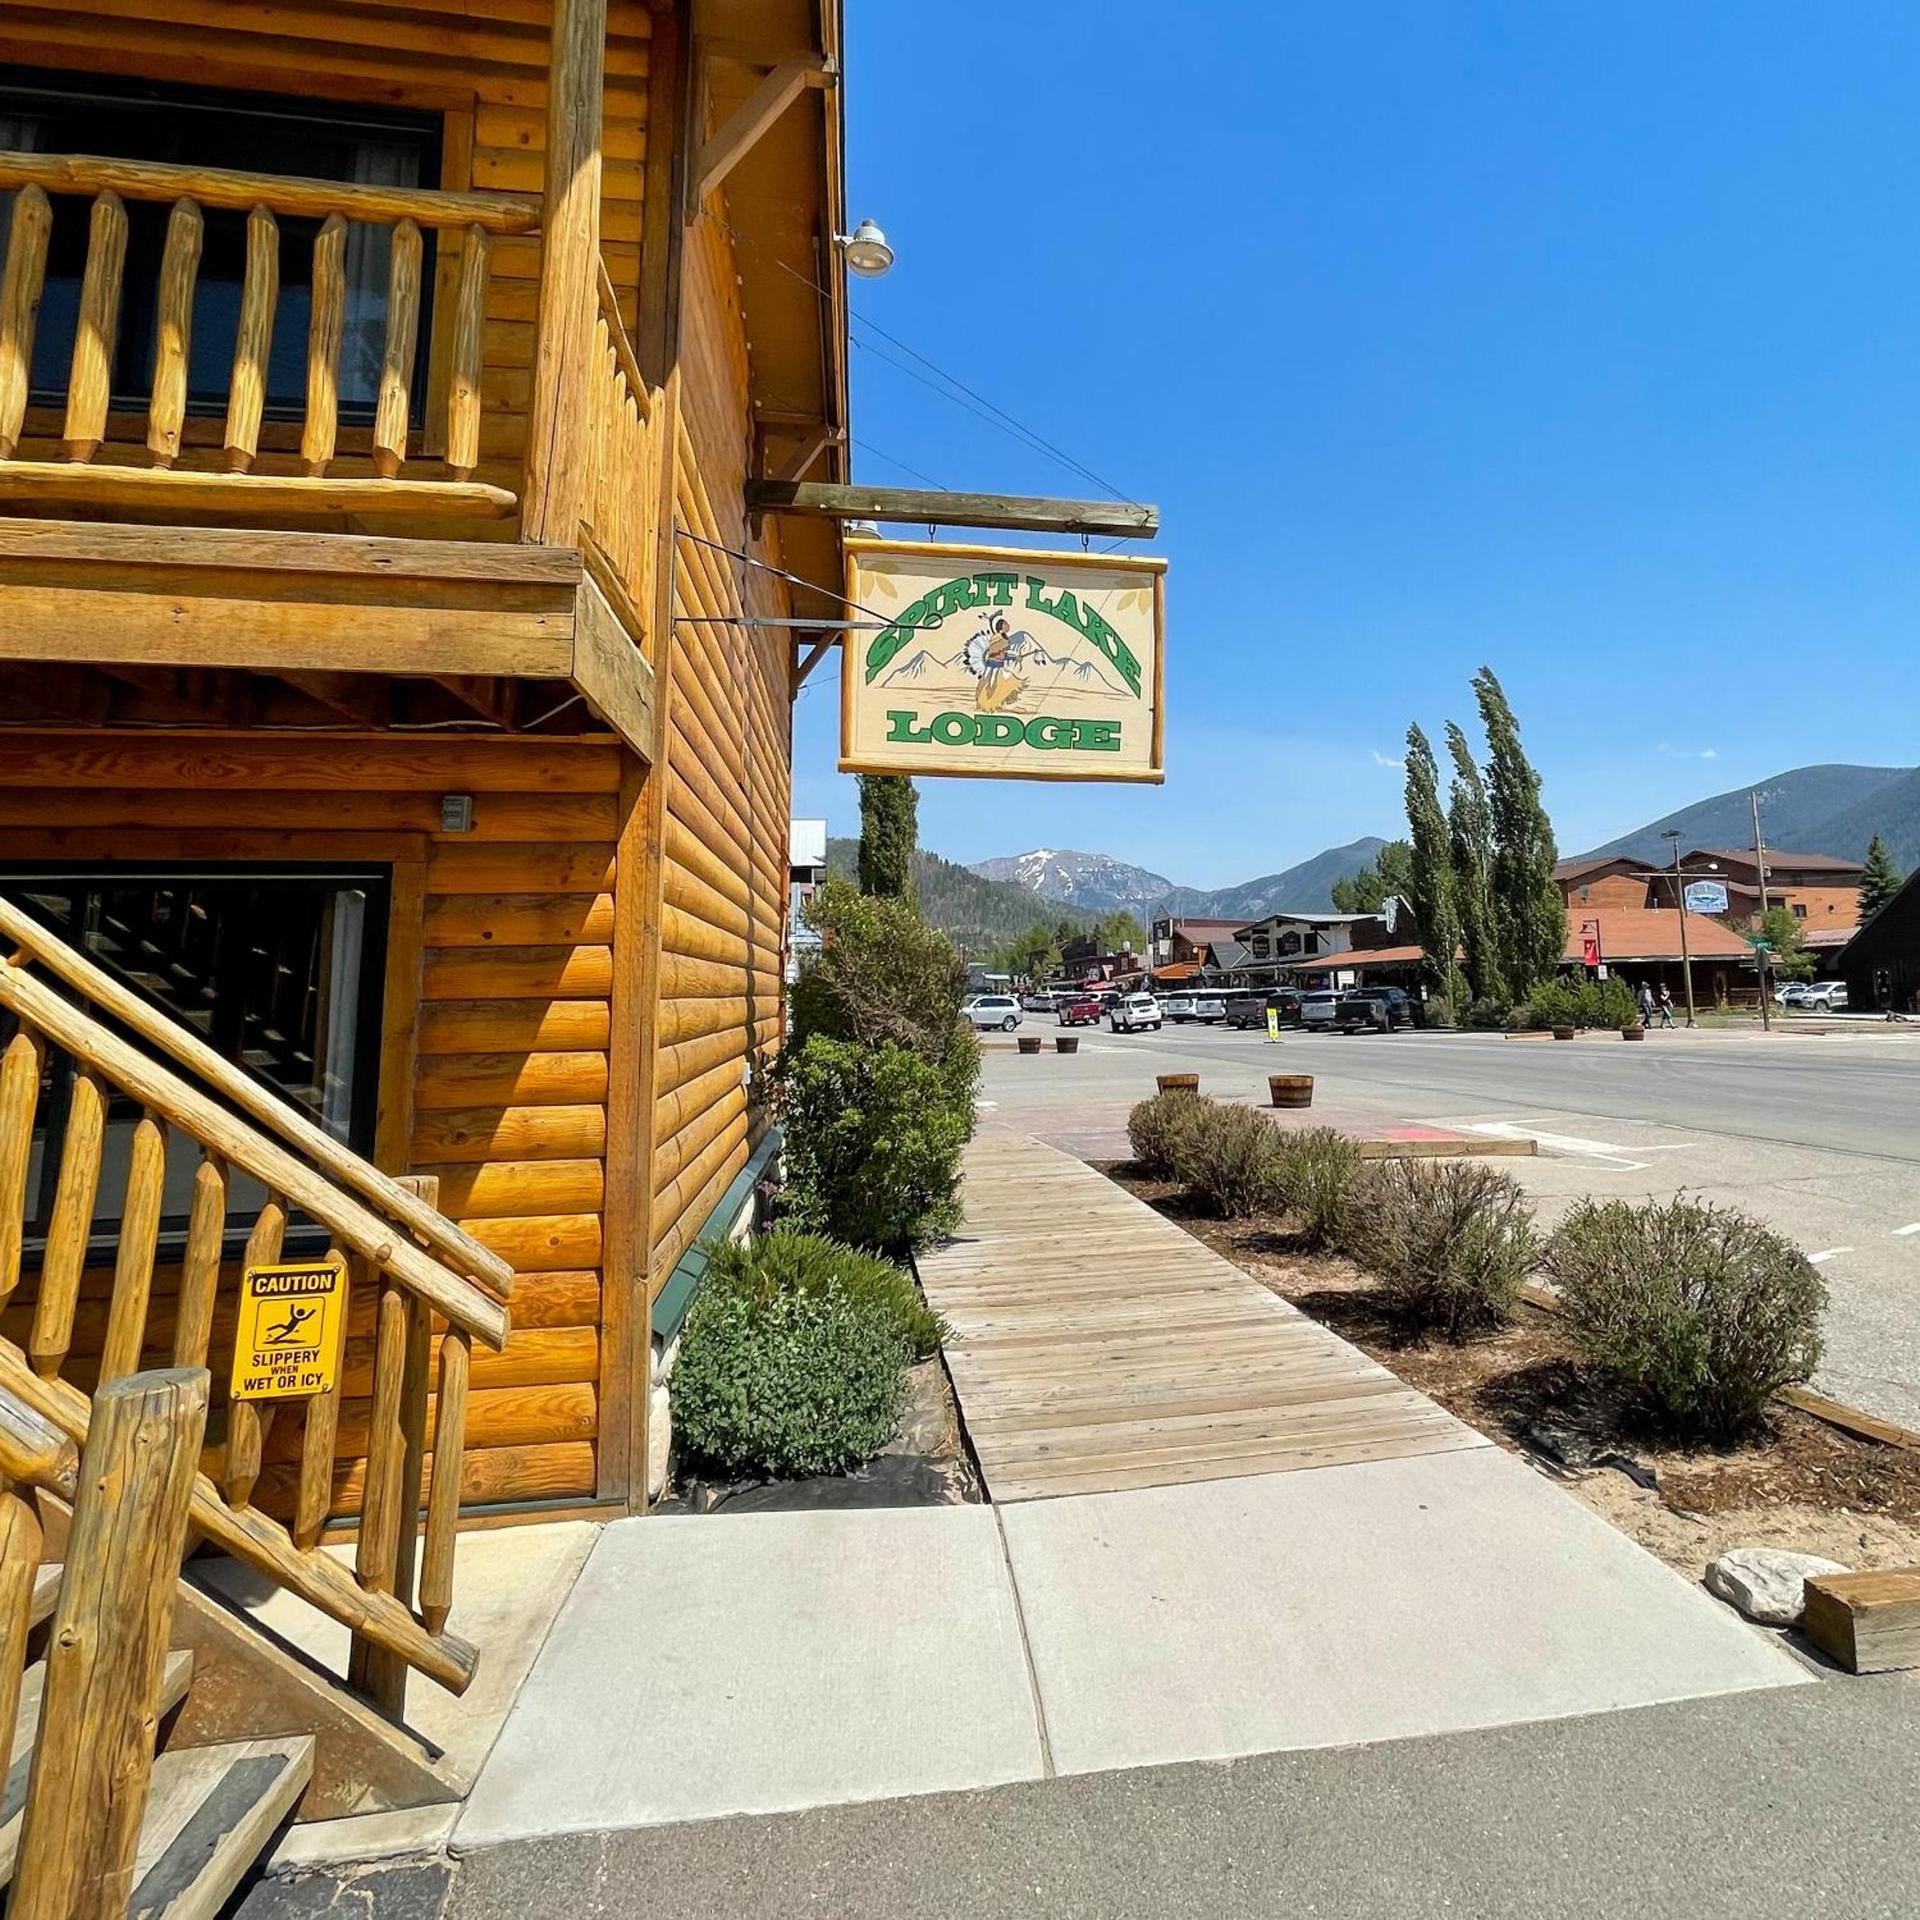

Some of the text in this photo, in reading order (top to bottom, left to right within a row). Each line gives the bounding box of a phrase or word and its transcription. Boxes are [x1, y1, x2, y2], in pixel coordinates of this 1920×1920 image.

[866, 572, 1142, 700] SPIRIT LAKE
[886, 710, 1121, 752] LODGE
[255, 1274, 332, 1293] CAUTION
[252, 1350, 320, 1367] SLIPPERY
[271, 1365, 299, 1375] WHEN
[244, 1377, 273, 1391] WET
[277, 1375, 296, 1388] OR
[301, 1373, 324, 1386] ICY
